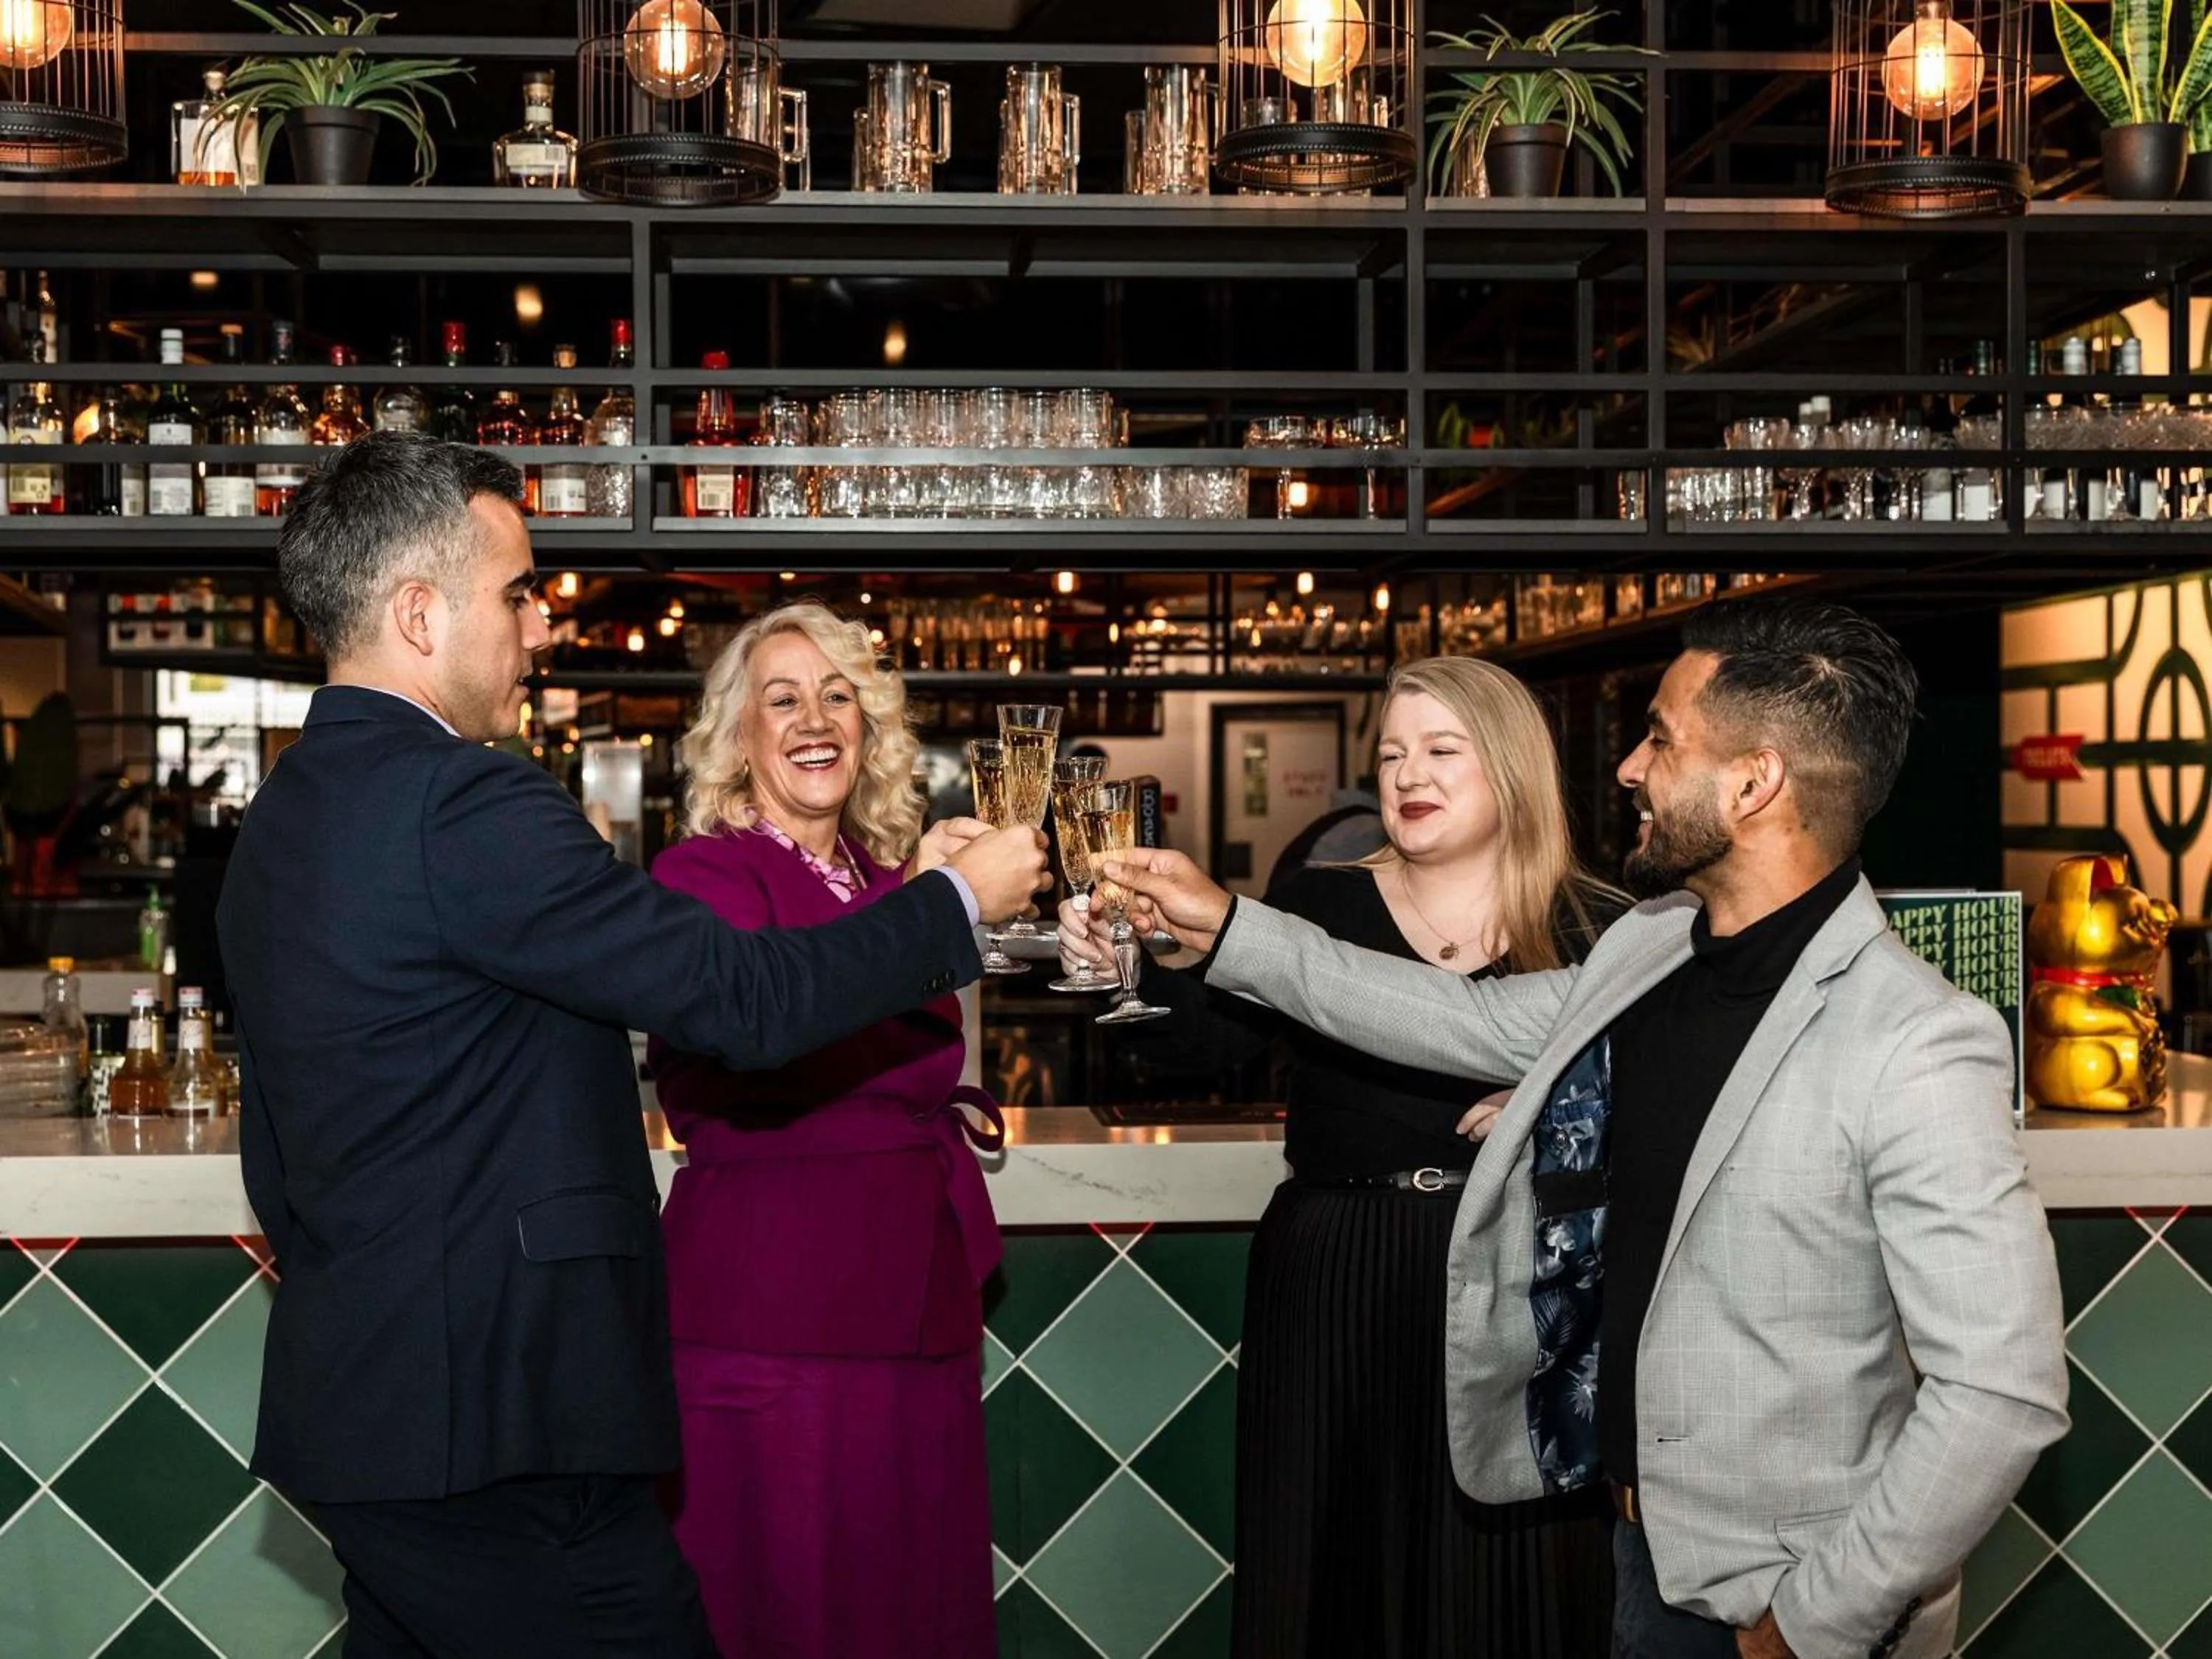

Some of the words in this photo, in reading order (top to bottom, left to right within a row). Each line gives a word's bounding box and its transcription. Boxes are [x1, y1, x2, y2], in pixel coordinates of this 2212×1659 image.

[1888, 904, 1947, 930] APPY
[1954, 897, 2018, 921] HOUR
[1954, 915, 2018, 939] HOUR
[1954, 933, 2018, 958] HOUR
[1954, 952, 2018, 976] HOUR
